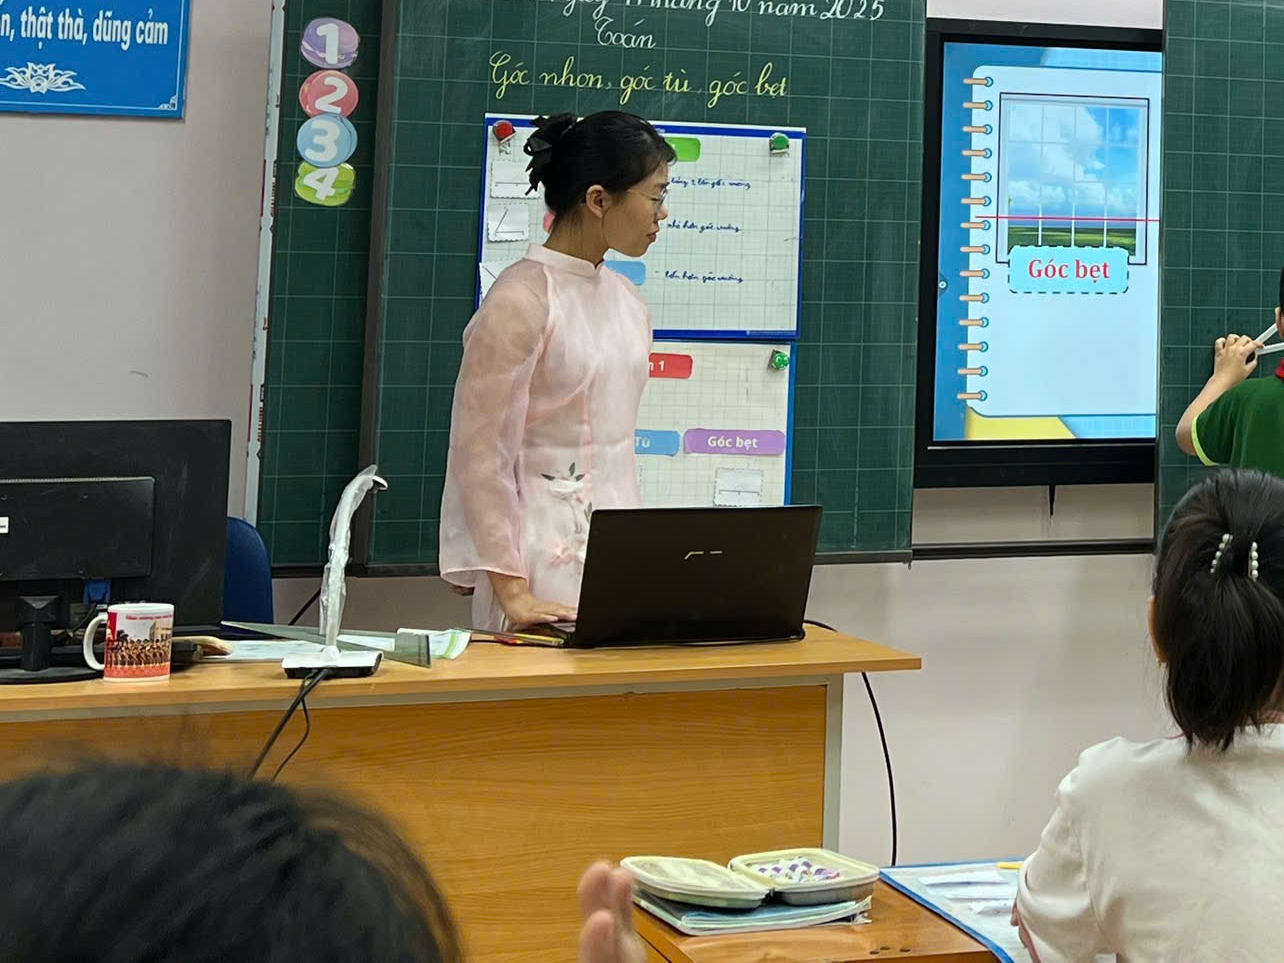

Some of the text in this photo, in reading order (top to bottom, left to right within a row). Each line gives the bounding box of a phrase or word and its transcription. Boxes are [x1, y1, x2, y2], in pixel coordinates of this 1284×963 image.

[20, 6, 53, 49] thật
[57, 8, 88, 46] thà,
[93, 10, 132, 51] dũng
[136, 8, 168, 45] cảm
[316, 22, 340, 65] 1
[594, 16, 657, 49] Toán
[314, 76, 348, 114] 2
[489, 50, 530, 99] Góc
[620, 65, 657, 105] góc
[708, 71, 749, 109] góc
[755, 62, 788, 99] bẹt
[304, 120, 341, 162] 3
[303, 167, 339, 201] 4
[1028, 258, 1110, 284] Góc bẹt
[707, 435, 758, 451] Góc bẹt
